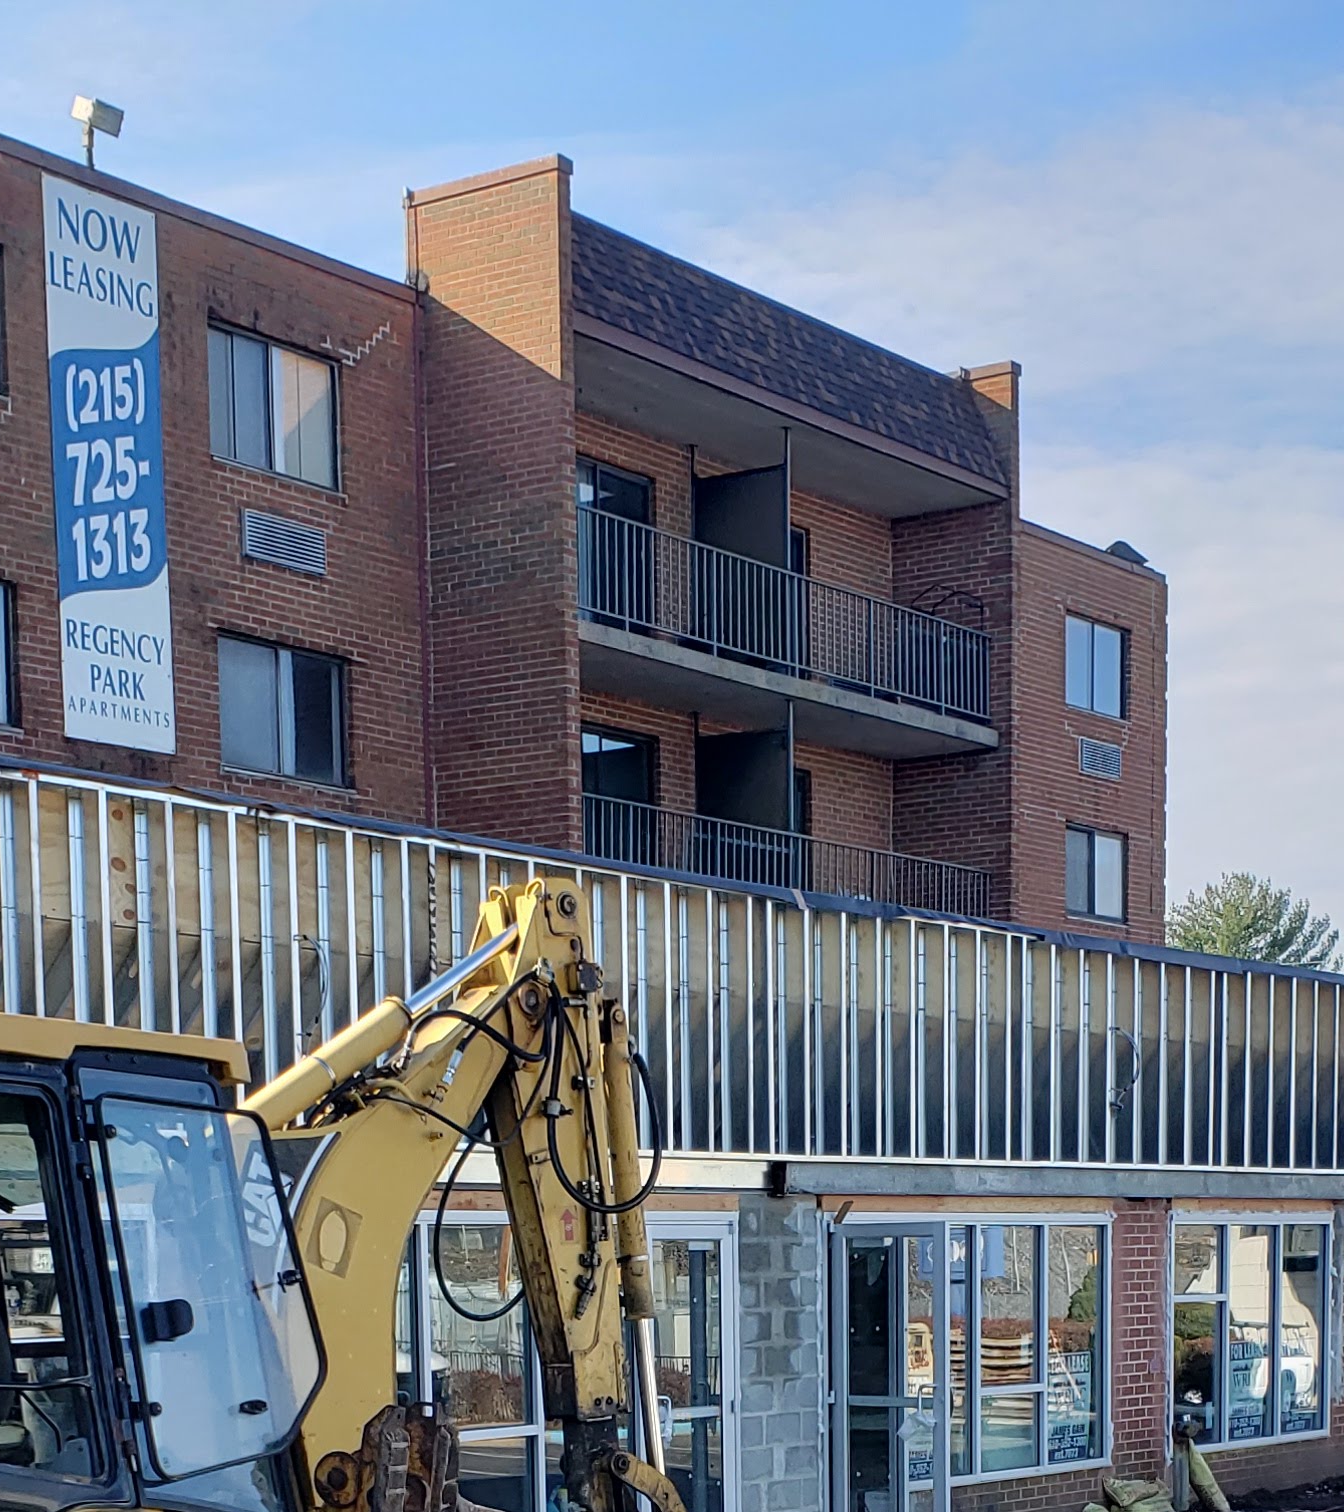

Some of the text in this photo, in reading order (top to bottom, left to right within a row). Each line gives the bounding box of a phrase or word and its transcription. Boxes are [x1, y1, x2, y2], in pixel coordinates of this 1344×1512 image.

[57, 197, 141, 264] NOW
[49, 250, 154, 318] LEASING
[66, 357, 146, 433] (215)
[66, 435, 150, 507] 725-
[72, 508, 152, 582] 1313
[66, 618, 165, 666] REGENCY
[68, 695, 171, 729] APARTMENTS
[90, 663, 146, 702] PARK
[242, 1150, 294, 1247] CAT
[1067, 1354, 1090, 1373] LEASE
[1230, 1343, 1243, 1360] FOR
